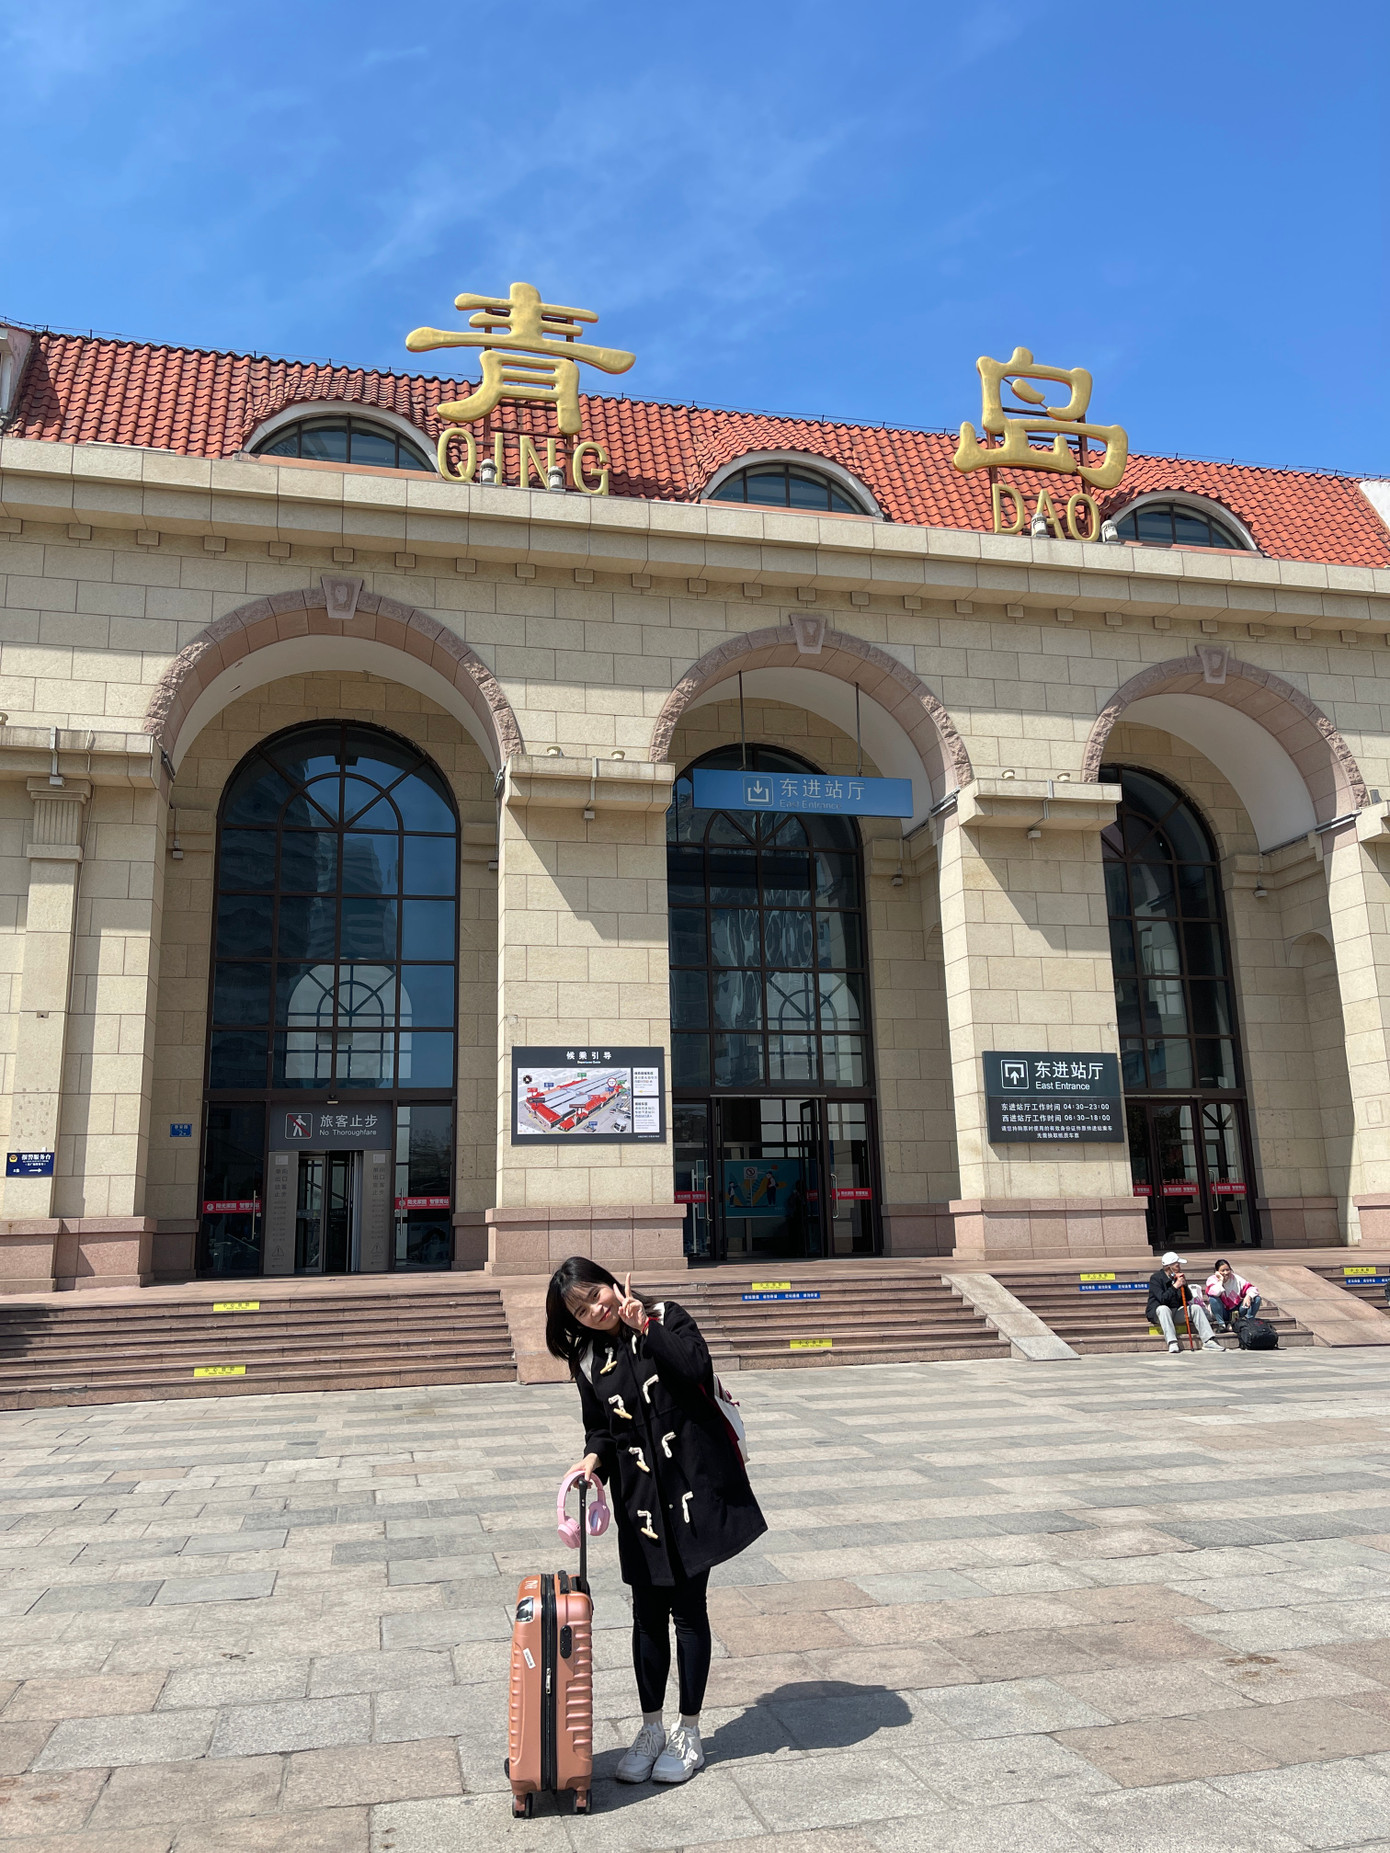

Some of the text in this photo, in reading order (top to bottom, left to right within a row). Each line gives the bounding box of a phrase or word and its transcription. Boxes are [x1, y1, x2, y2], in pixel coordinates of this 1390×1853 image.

[406, 282, 636, 435] 青
[953, 346, 1129, 490] 岛
[438, 427, 610, 496] QING
[992, 482, 1100, 542] DAO
[779, 778, 865, 800] 东进站厅
[780, 800, 842, 810] East Entrance
[1034, 1060, 1104, 1080] 东进站厅
[1035, 1081, 1091, 1091] East Entrance
[1001, 1103, 1061, 1111] 东进站厅工作时间
[320, 1114, 378, 1128] 旅客止步
[1002, 1114, 1062, 1122] 西进站厅工作时间
[333, 1129, 377, 1137] Thoroughfare
